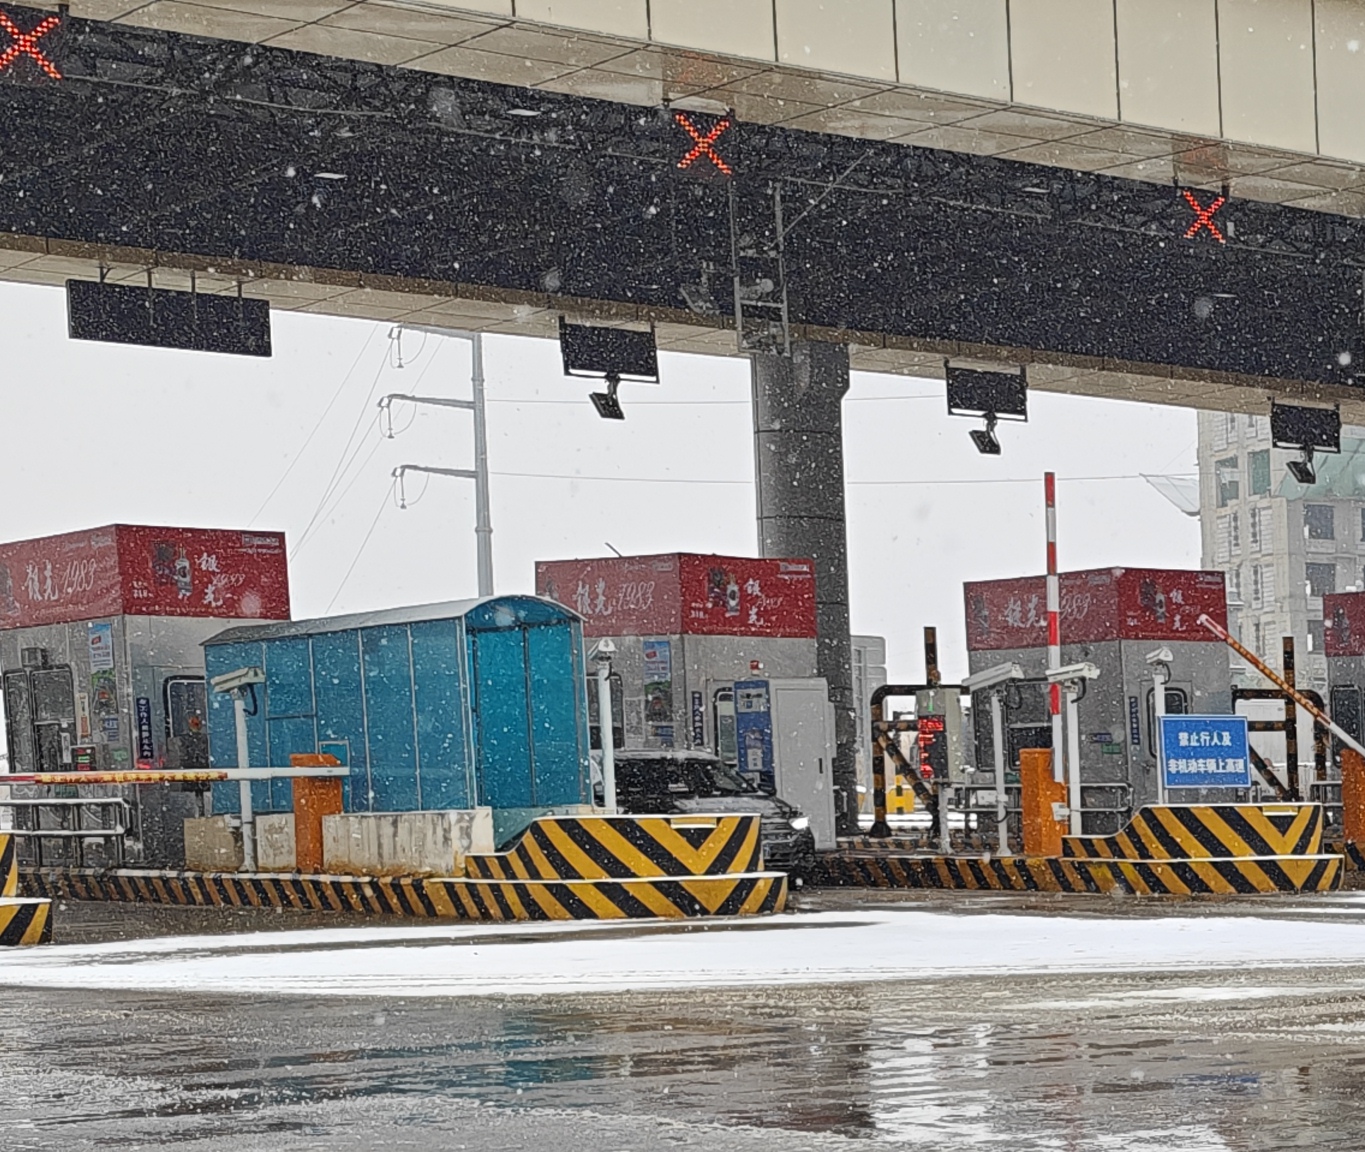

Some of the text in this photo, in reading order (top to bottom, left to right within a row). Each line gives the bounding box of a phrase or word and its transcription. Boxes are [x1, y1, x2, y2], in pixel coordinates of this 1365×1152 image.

[1178, 731, 1232, 747] 禁止行人及
[1168, 758, 1246, 774] 非机动车辆上高速
